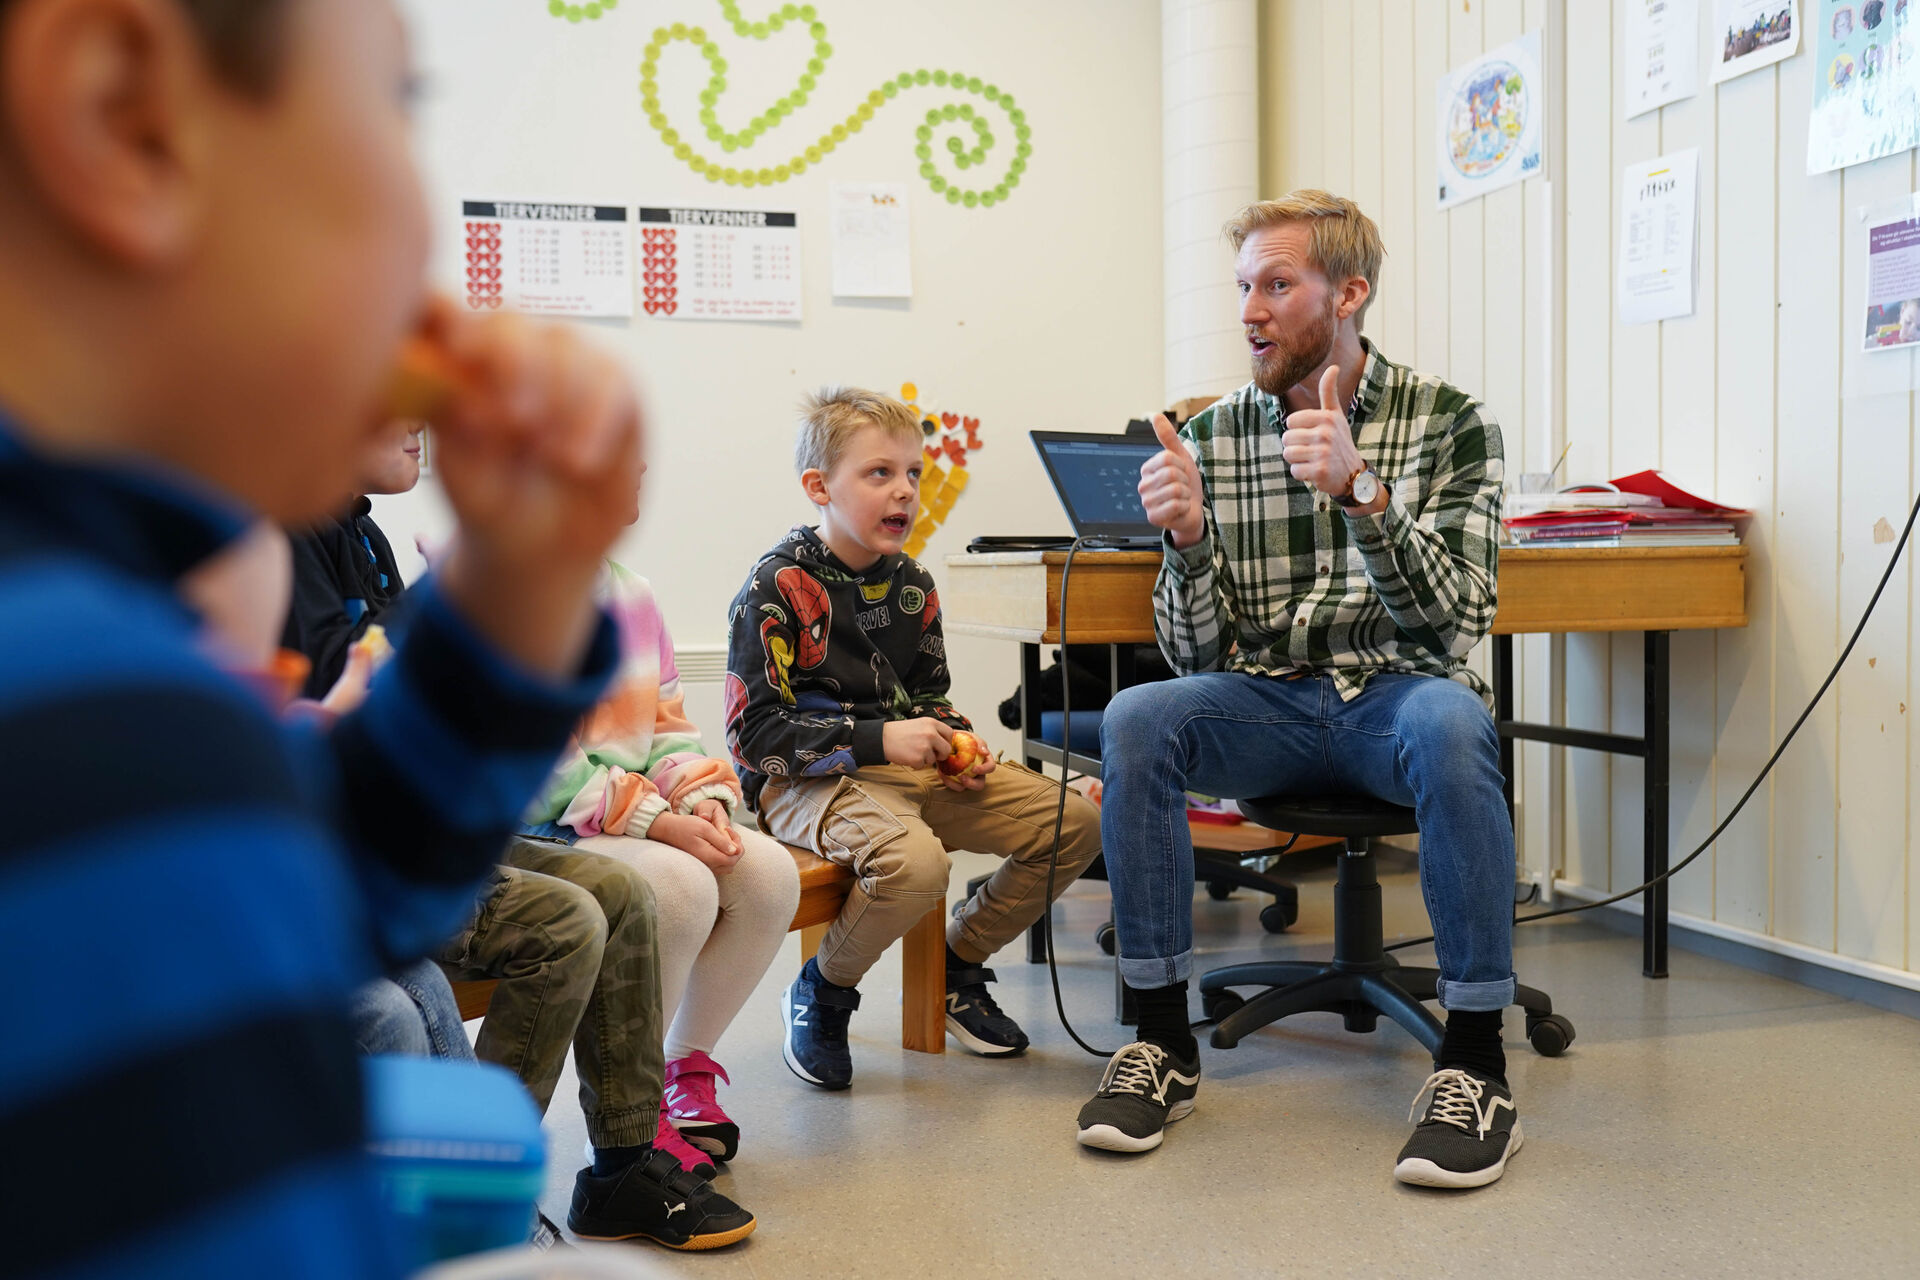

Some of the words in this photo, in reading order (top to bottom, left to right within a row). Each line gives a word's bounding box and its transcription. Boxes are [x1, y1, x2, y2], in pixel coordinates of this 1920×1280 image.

[494, 203, 597, 221] TIERVENNER
[669, 209, 767, 227] TIERVENNER
[793, 1004, 809, 1027] N
